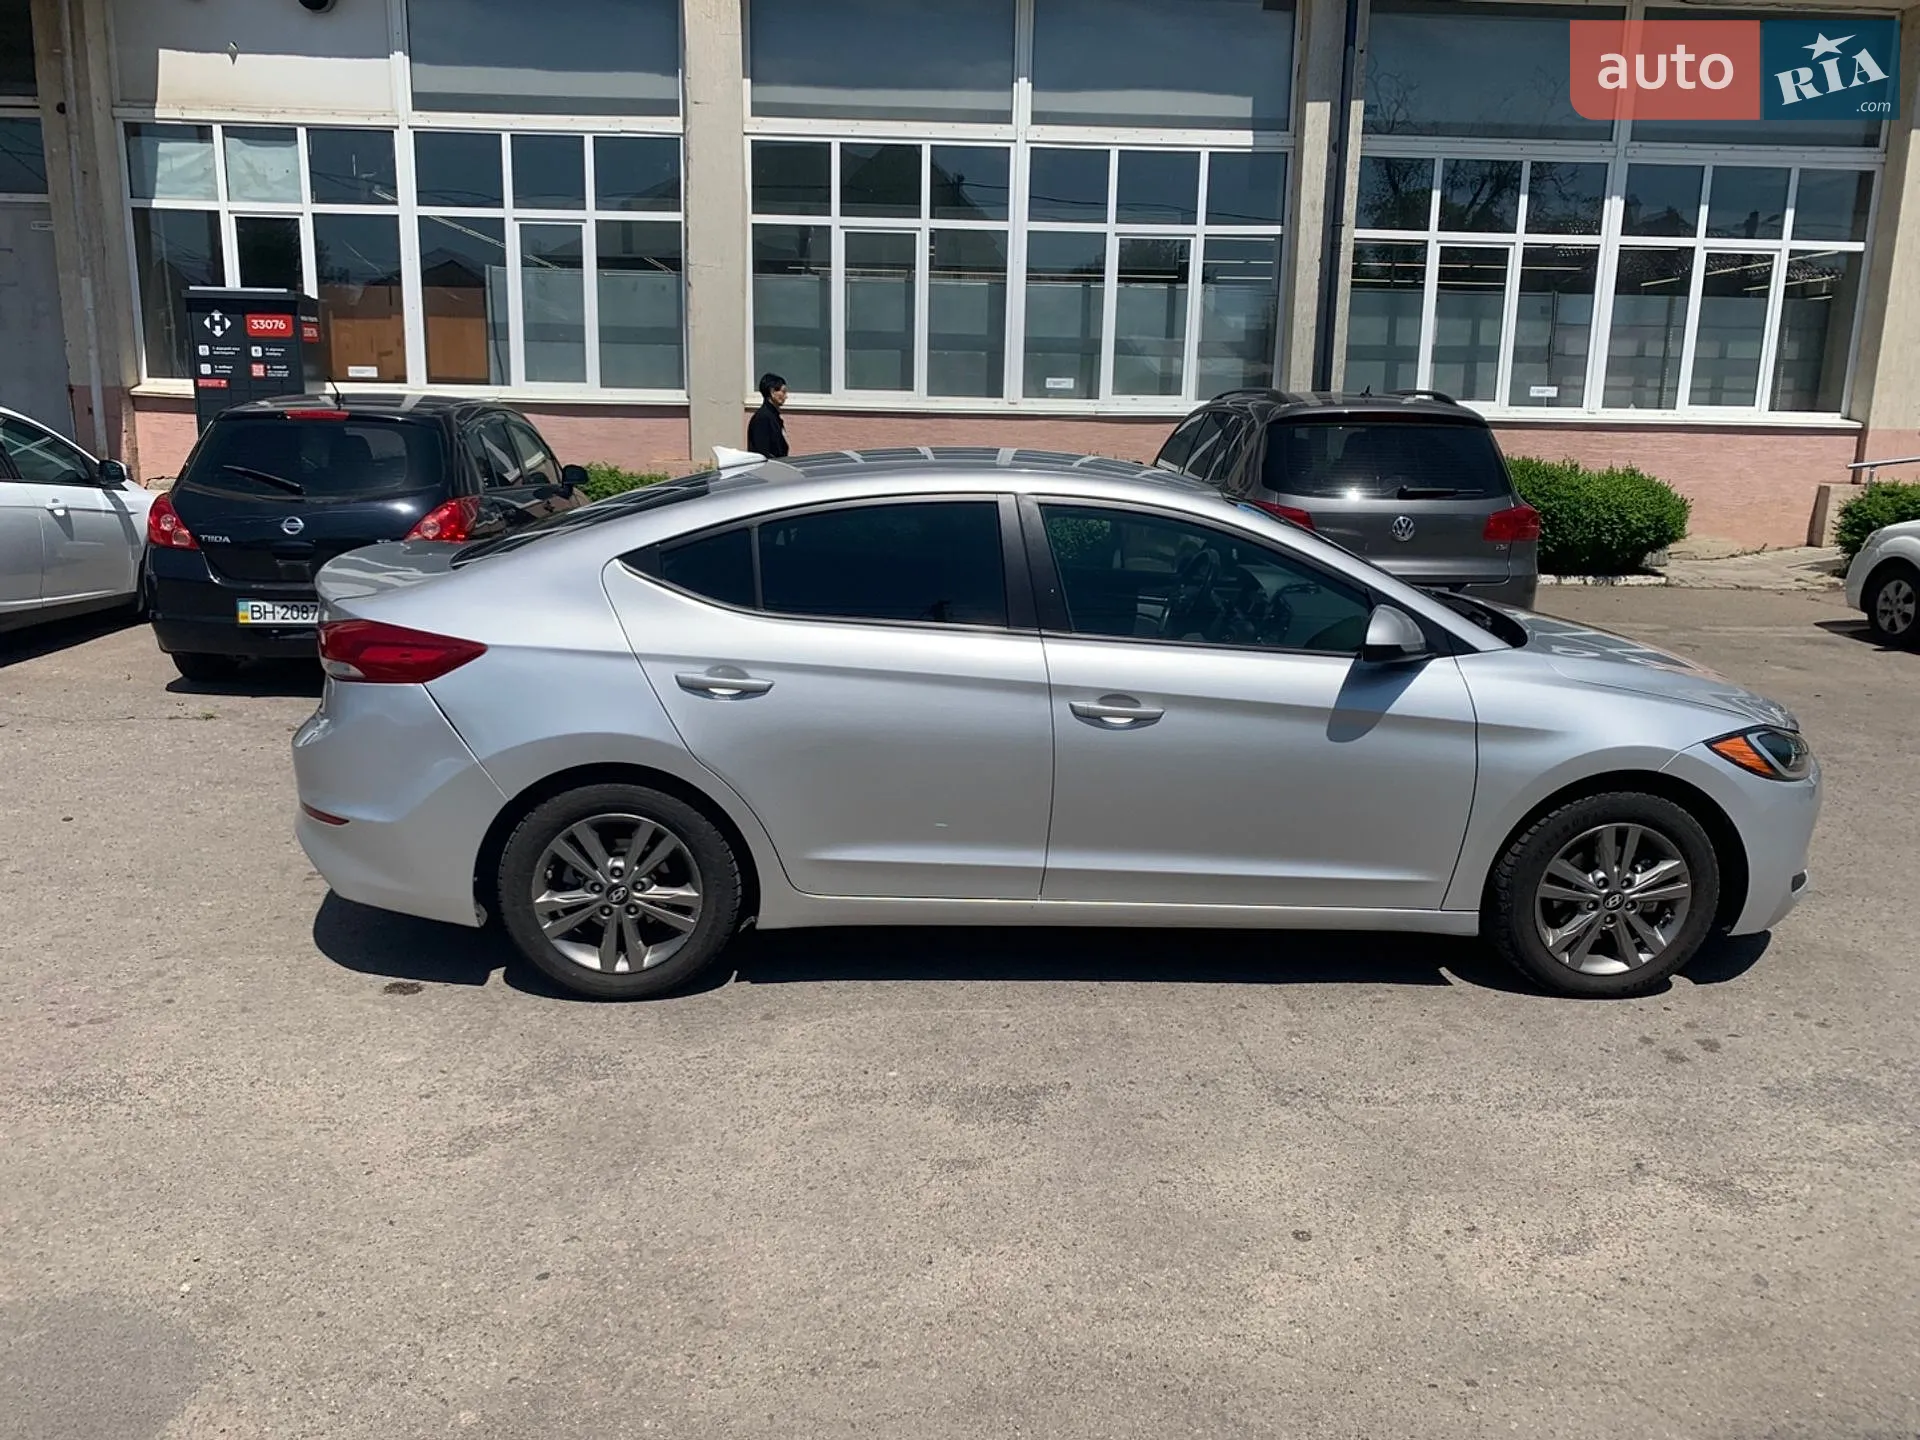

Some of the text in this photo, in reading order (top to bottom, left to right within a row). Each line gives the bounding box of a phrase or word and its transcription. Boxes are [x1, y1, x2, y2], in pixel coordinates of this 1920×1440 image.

[251, 319, 286, 330] 33076
[200, 534, 231, 543] TIIDA
[280, 604, 319, 621] 2087
